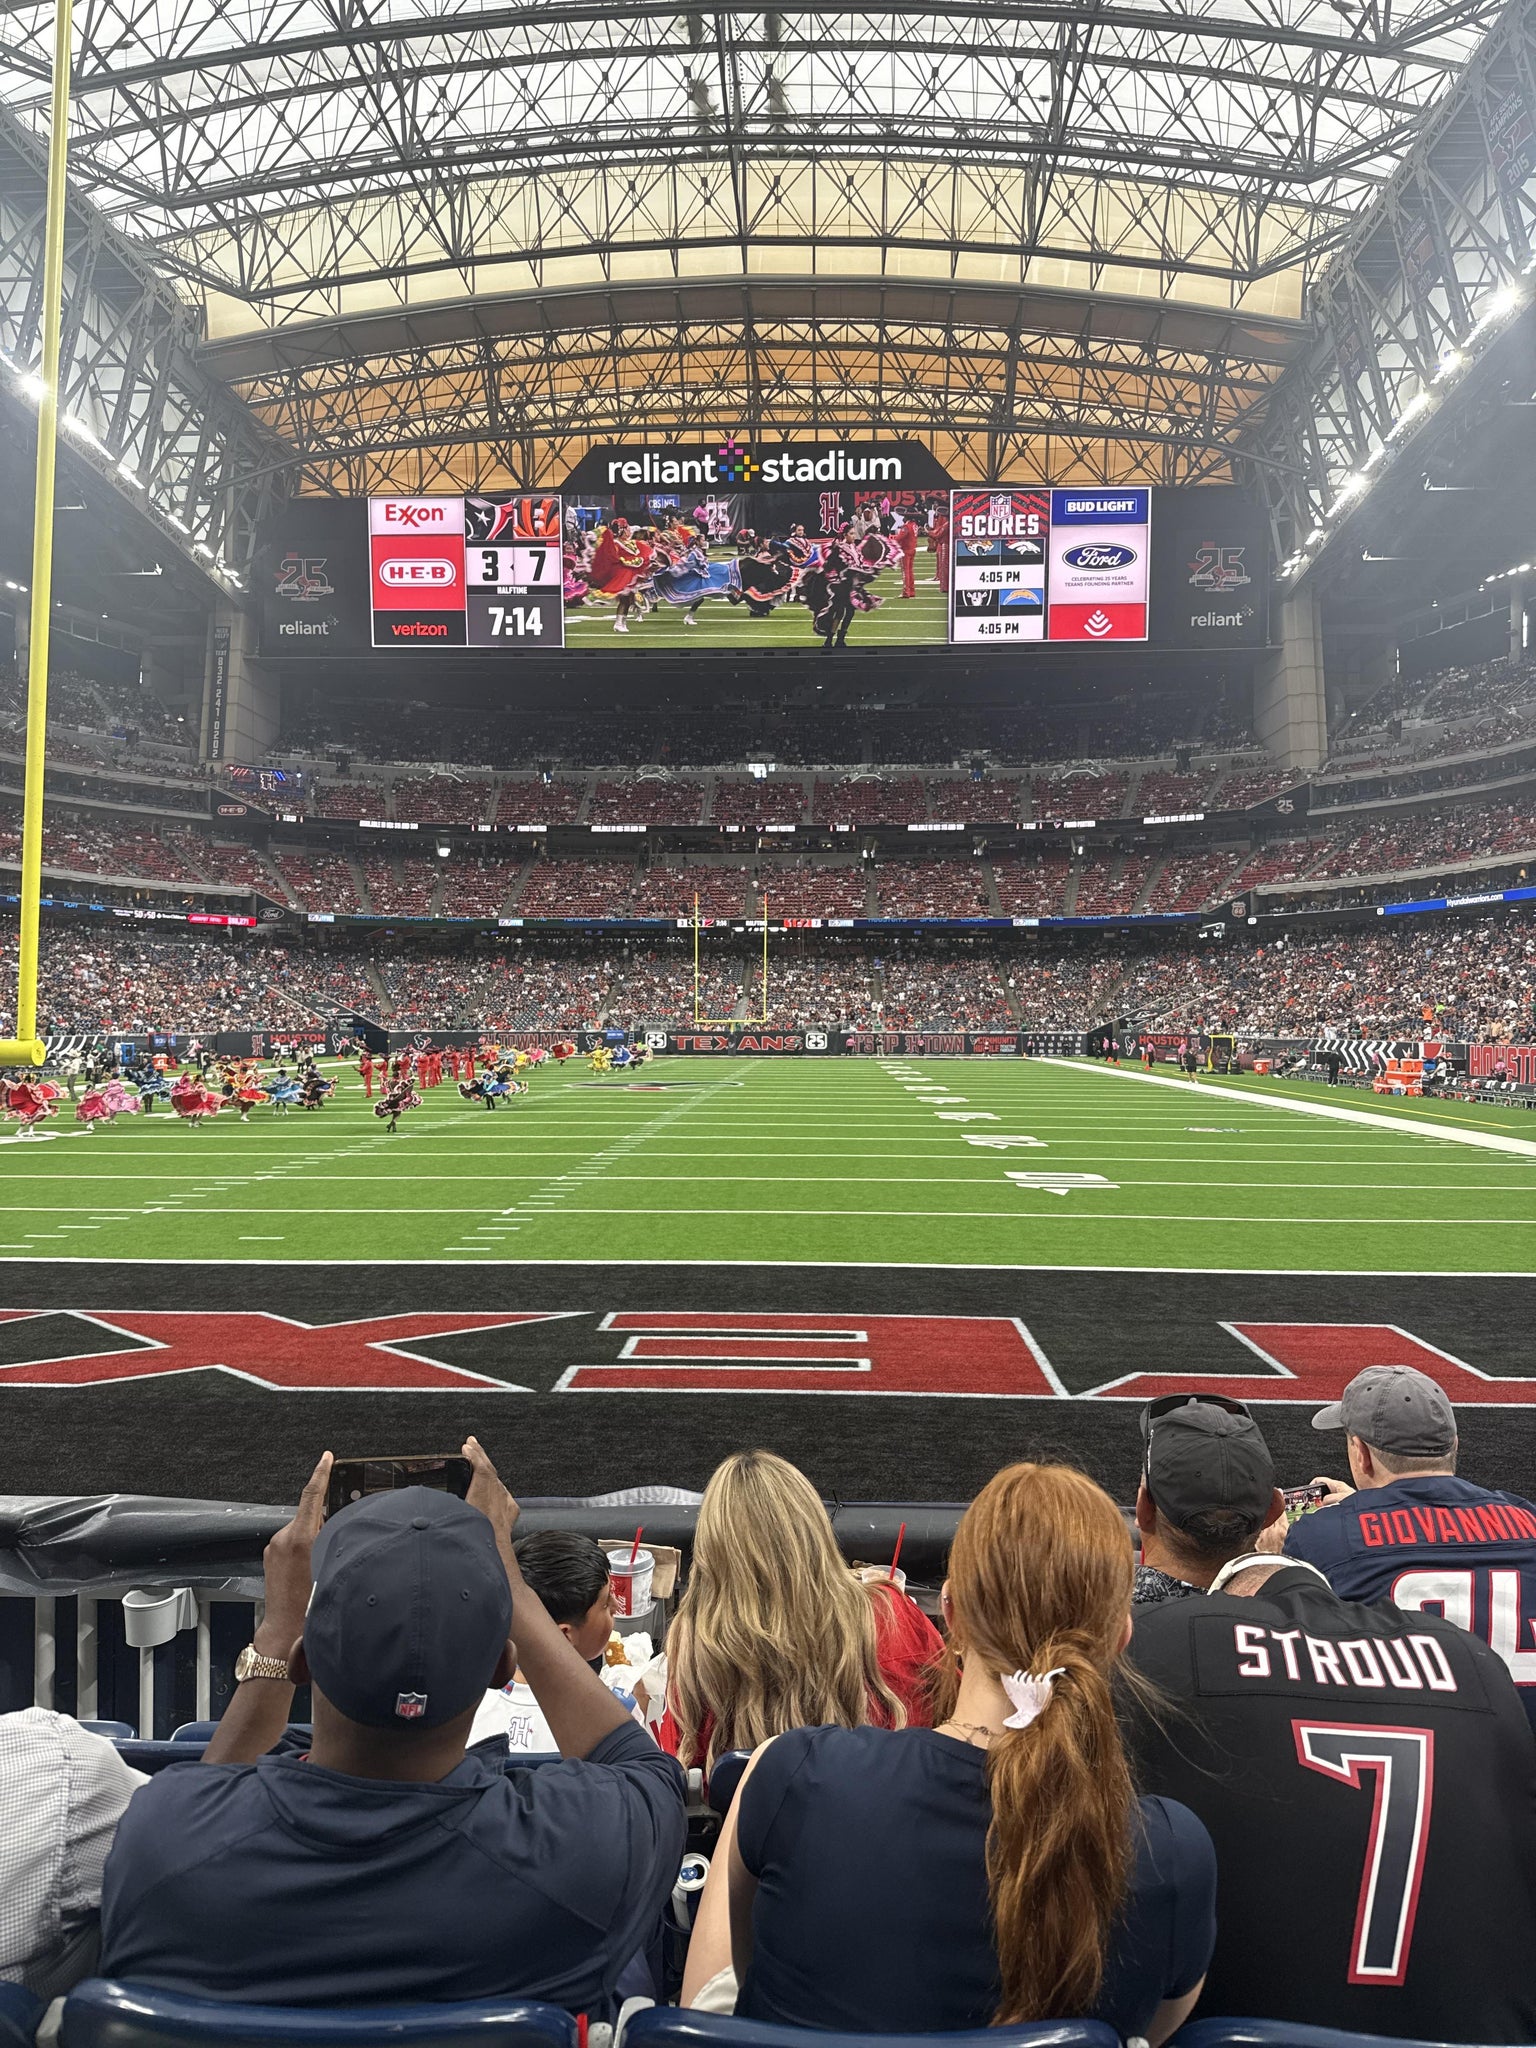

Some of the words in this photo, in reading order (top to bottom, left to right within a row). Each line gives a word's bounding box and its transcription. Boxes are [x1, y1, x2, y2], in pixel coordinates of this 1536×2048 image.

[1488, 95, 1523, 142] CHAMPIONS
[1506, 152, 1530, 186] 2015
[608, 452, 718, 484] reliant
[761, 450, 902, 482] stadium
[993, 506, 1008, 516] NFL
[1067, 501, 1095, 513] BUD
[1096, 500, 1135, 512] LIGHT
[385, 504, 444, 528] Exxon
[961, 514, 1039, 537] SCORES
[1076, 547, 1122, 566] Ford
[482, 550, 499, 582] 3
[529, 550, 547, 582] 7
[979, 572, 1002, 583] 4:05
[1006, 571, 1020, 582] PM
[497, 586, 528, 595] HALFTIME
[279, 620, 329, 635] reliant
[488, 607, 543, 636] 7:14
[978, 623, 1002, 634] 4:05
[1005, 622, 1019, 634] PM
[1190, 612, 1243, 627] reliant
[391, 622, 448, 636] verizon
[262, 909, 280, 918] Ford
[269, 1033, 326, 1043] HOUSTON
[669, 1035, 804, 1051] TEXANS
[923, 1034, 965, 1053] TOWN
[1139, 1035, 1188, 1046] HOUSTON
[1233, 1624, 1458, 1693] STROUD
[399, 1704, 421, 1715] NFL
[509, 1716, 532, 1749] H
[1290, 1718, 1435, 1987] 7
